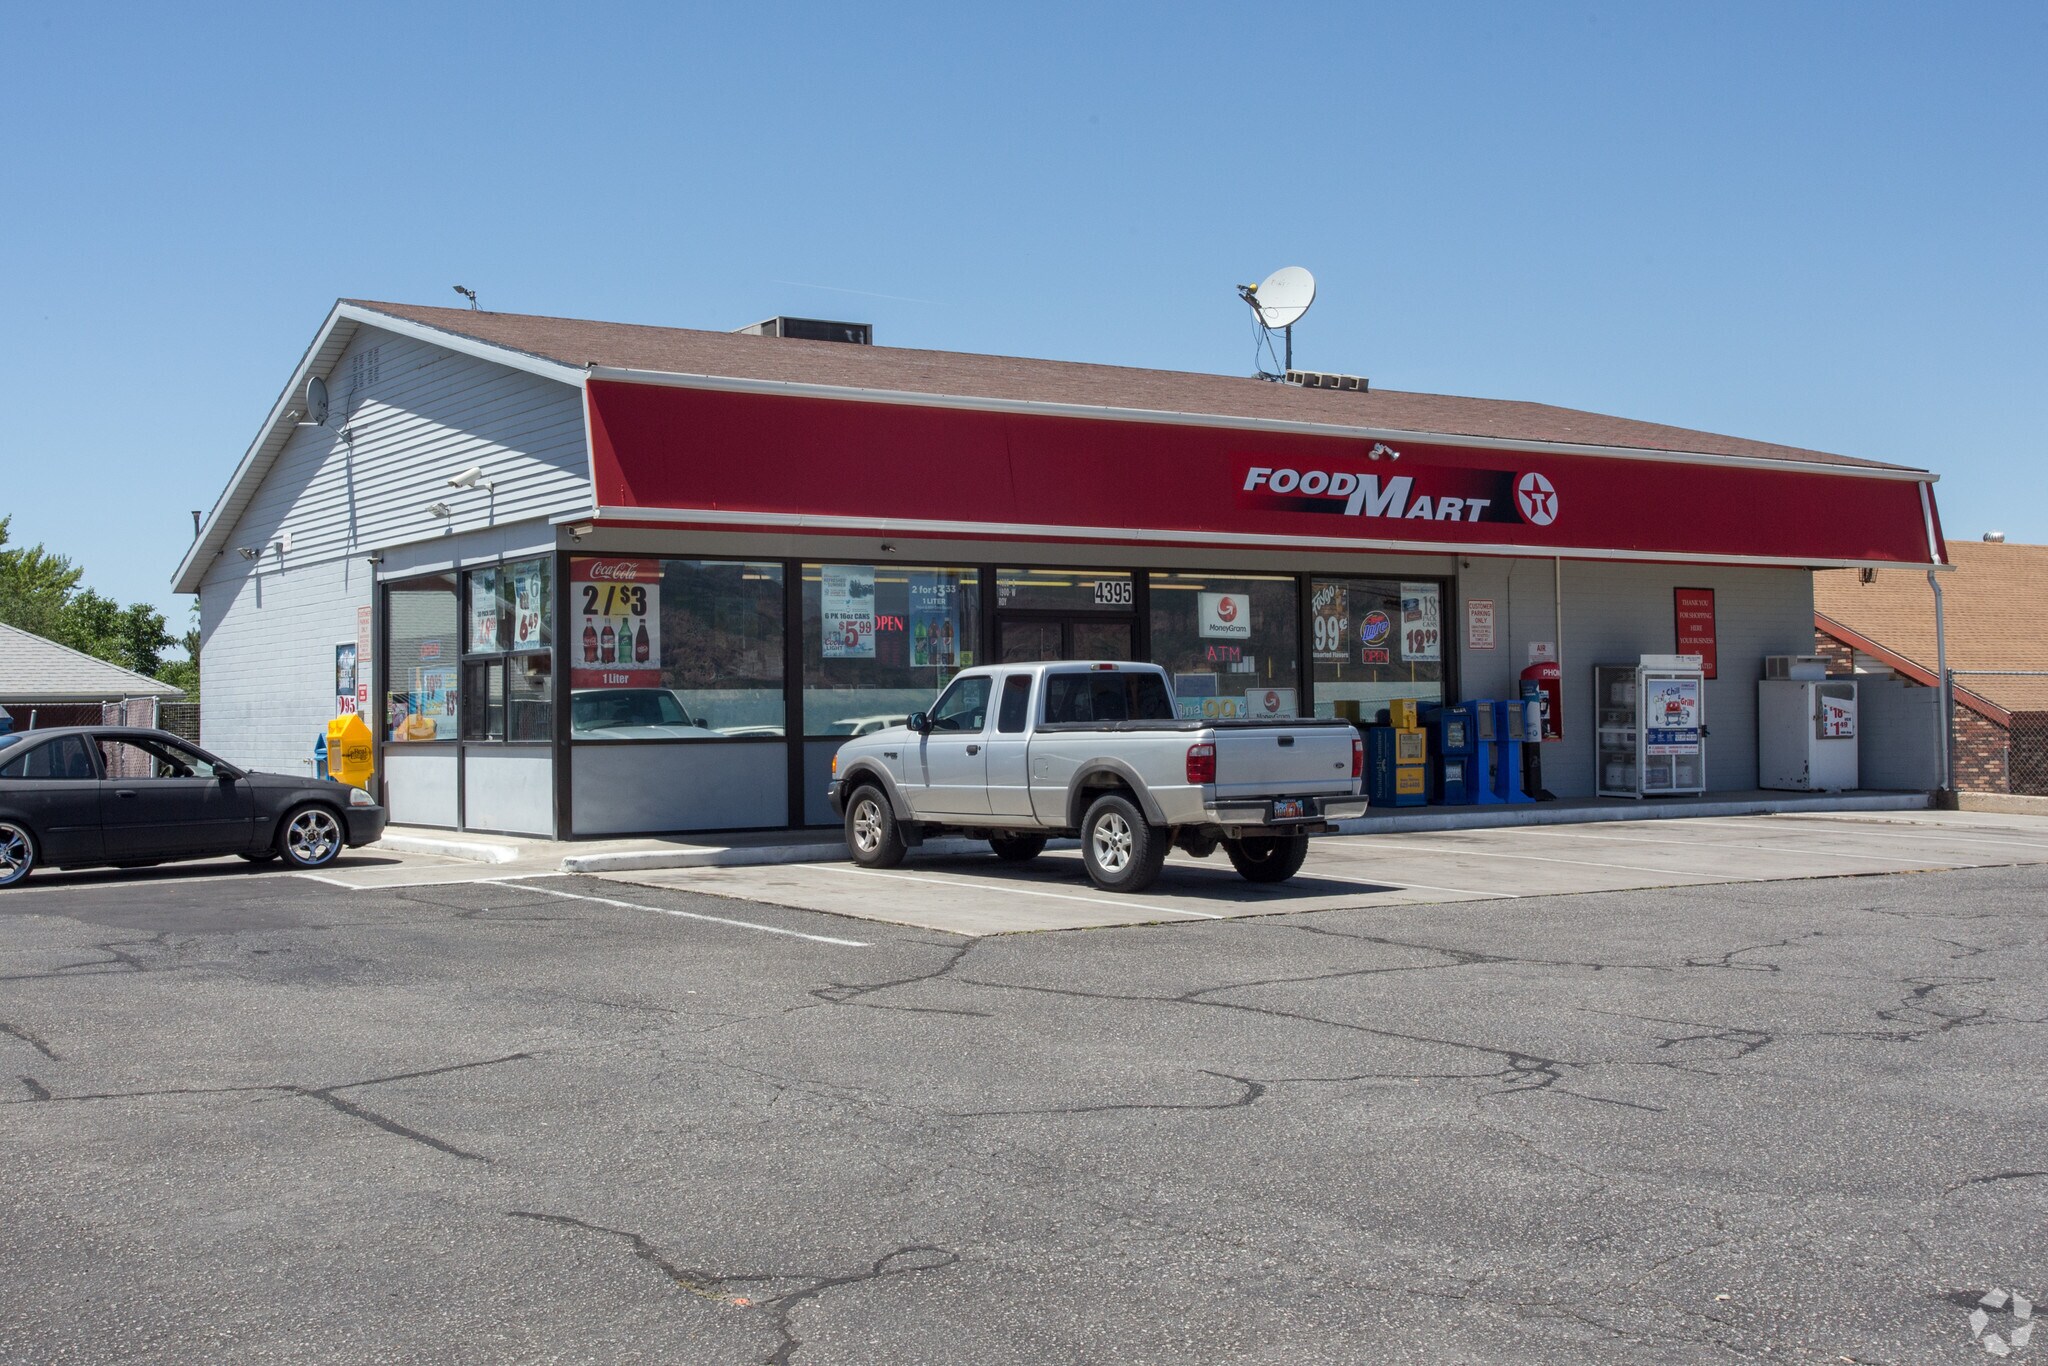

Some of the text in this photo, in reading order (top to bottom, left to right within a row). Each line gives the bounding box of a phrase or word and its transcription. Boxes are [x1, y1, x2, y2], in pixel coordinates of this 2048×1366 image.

[1243, 467, 1491, 522] FOOD MART
[590, 561, 639, 580] Coca-Cola
[1095, 582, 1132, 603] 4395
[1312, 586, 1334, 616] Faygo
[1423, 596, 1437, 616] 18
[1209, 624, 1247, 633] MoneyGram
[1207, 645, 1241, 661] ATM
[1364, 651, 1387, 662] OPEN
[603, 673, 629, 684] 1 Liter
[1543, 669, 1560, 677] PHO
[1666, 687, 1680, 695] Chill
